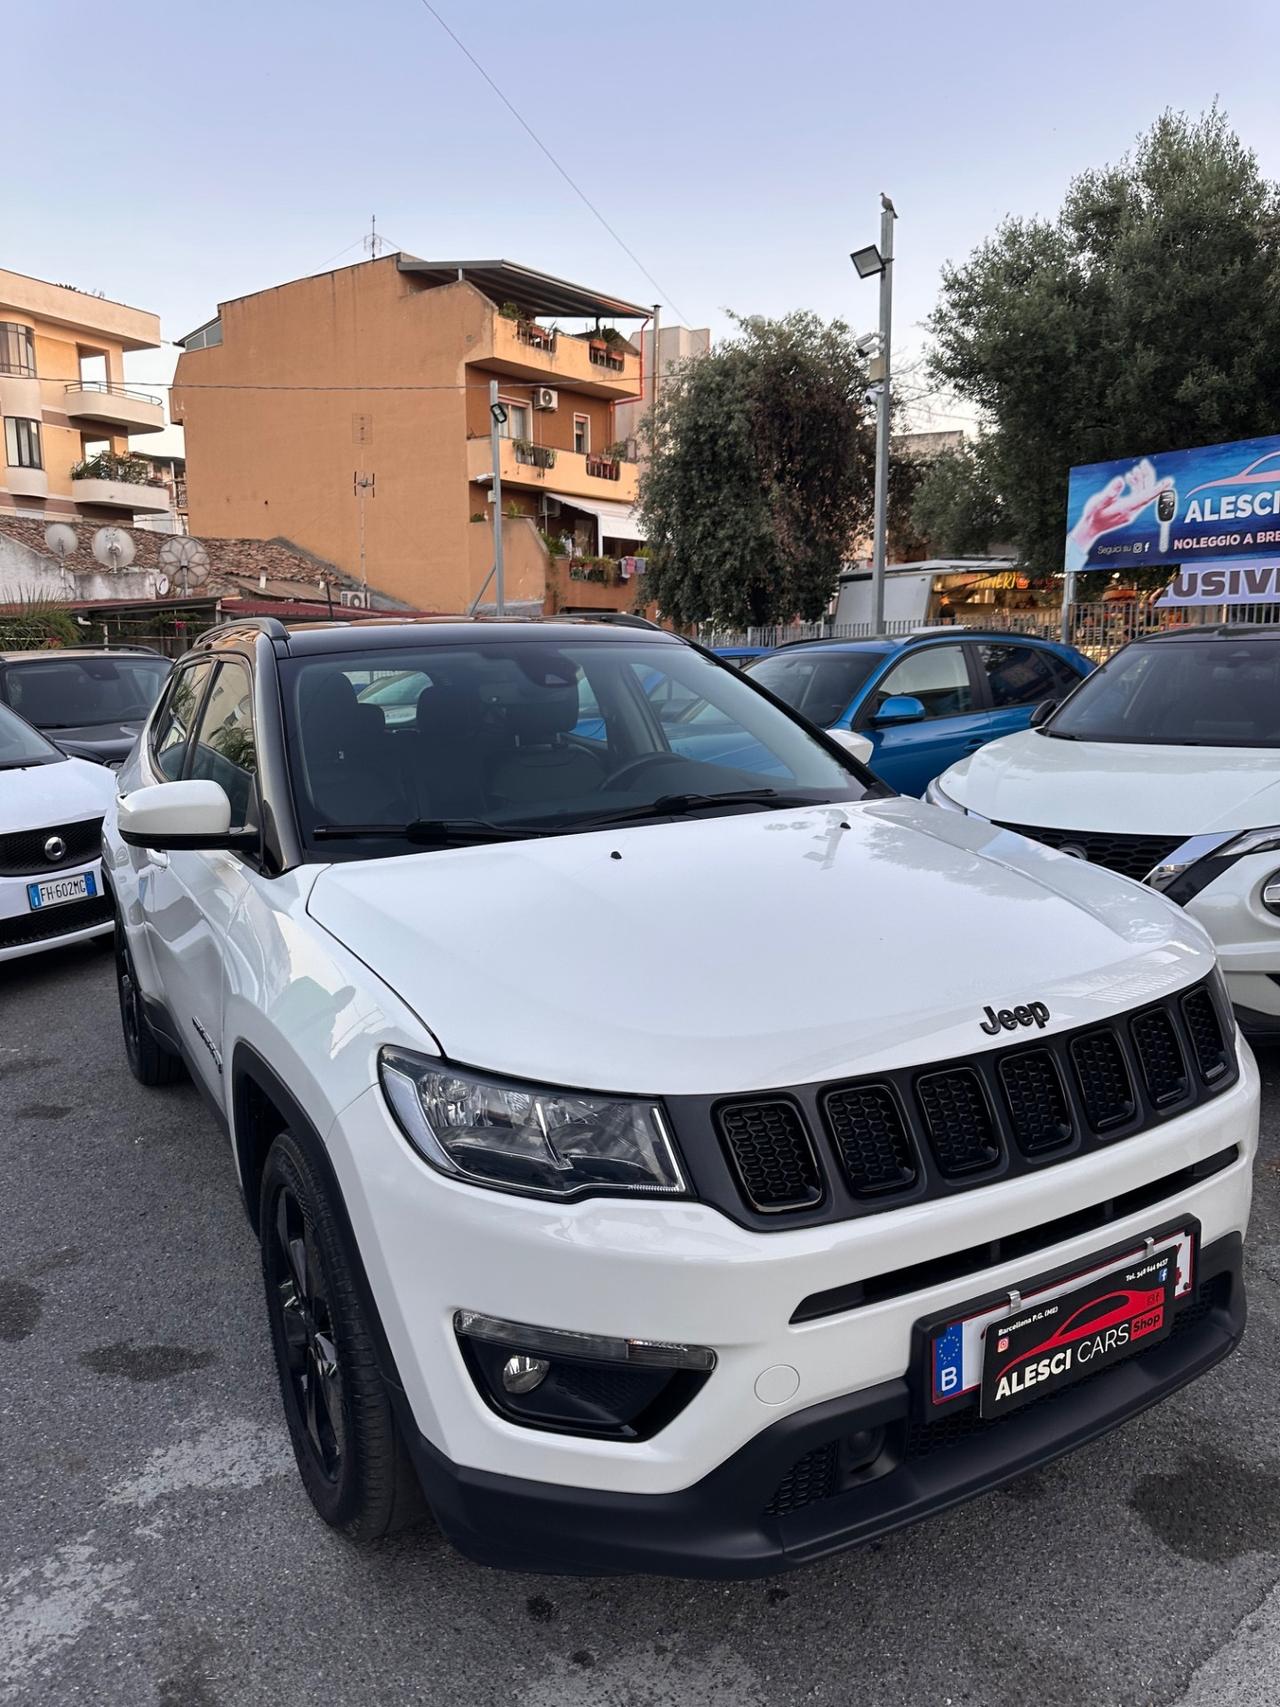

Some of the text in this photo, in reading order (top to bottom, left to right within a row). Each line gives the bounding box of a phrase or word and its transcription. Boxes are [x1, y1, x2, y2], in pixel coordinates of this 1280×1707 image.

[1184, 490, 1280, 524] ALESCI
[1173, 534, 1240, 550] NOLEGGIO
[1243, 532, 1253, 545] A
[1162, 568, 1280, 598] USIV
[979, 1001, 1050, 1035] Jeep
[995, 1314, 1160, 1401] ALESCI CARS Shop
[941, 1366, 957, 1392] B
